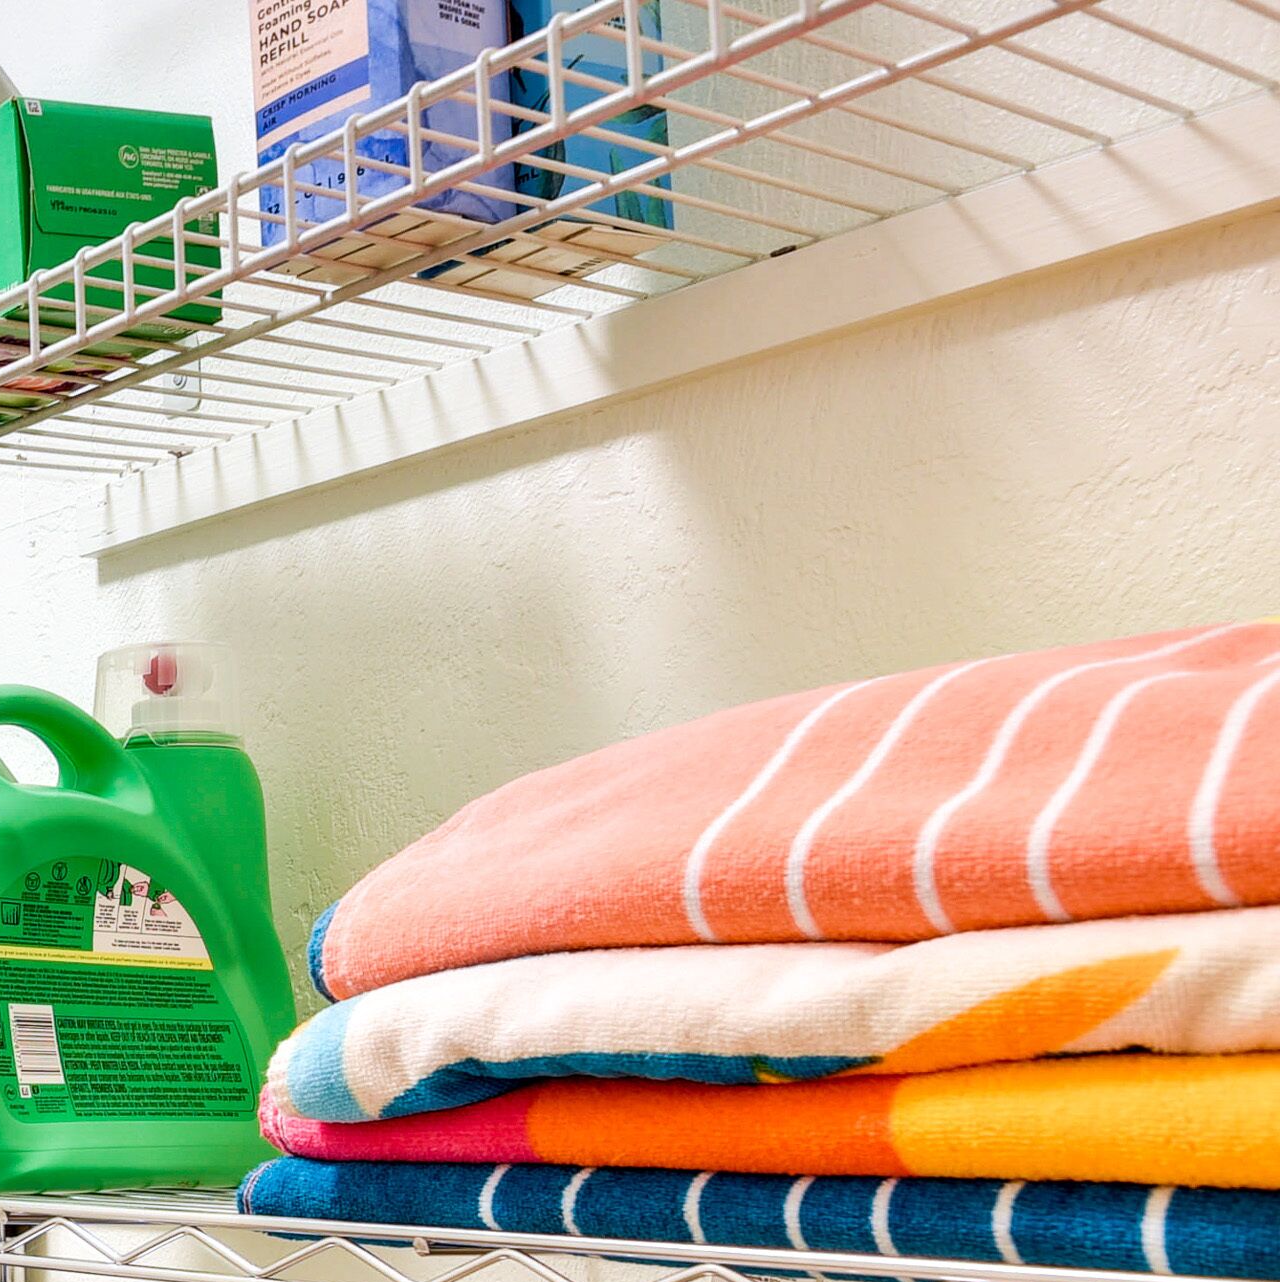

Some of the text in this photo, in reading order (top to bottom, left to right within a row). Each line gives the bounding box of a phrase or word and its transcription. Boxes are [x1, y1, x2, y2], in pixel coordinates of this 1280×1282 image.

[257, 0, 295, 20] Gent
[258, 0, 312, 34] Foaming
[260, 19, 302, 51] HAND
[260, 32, 309, 67] REFILL
[262, 74, 337, 119] CRISP MORNING
[262, 118, 277, 131] AIR
